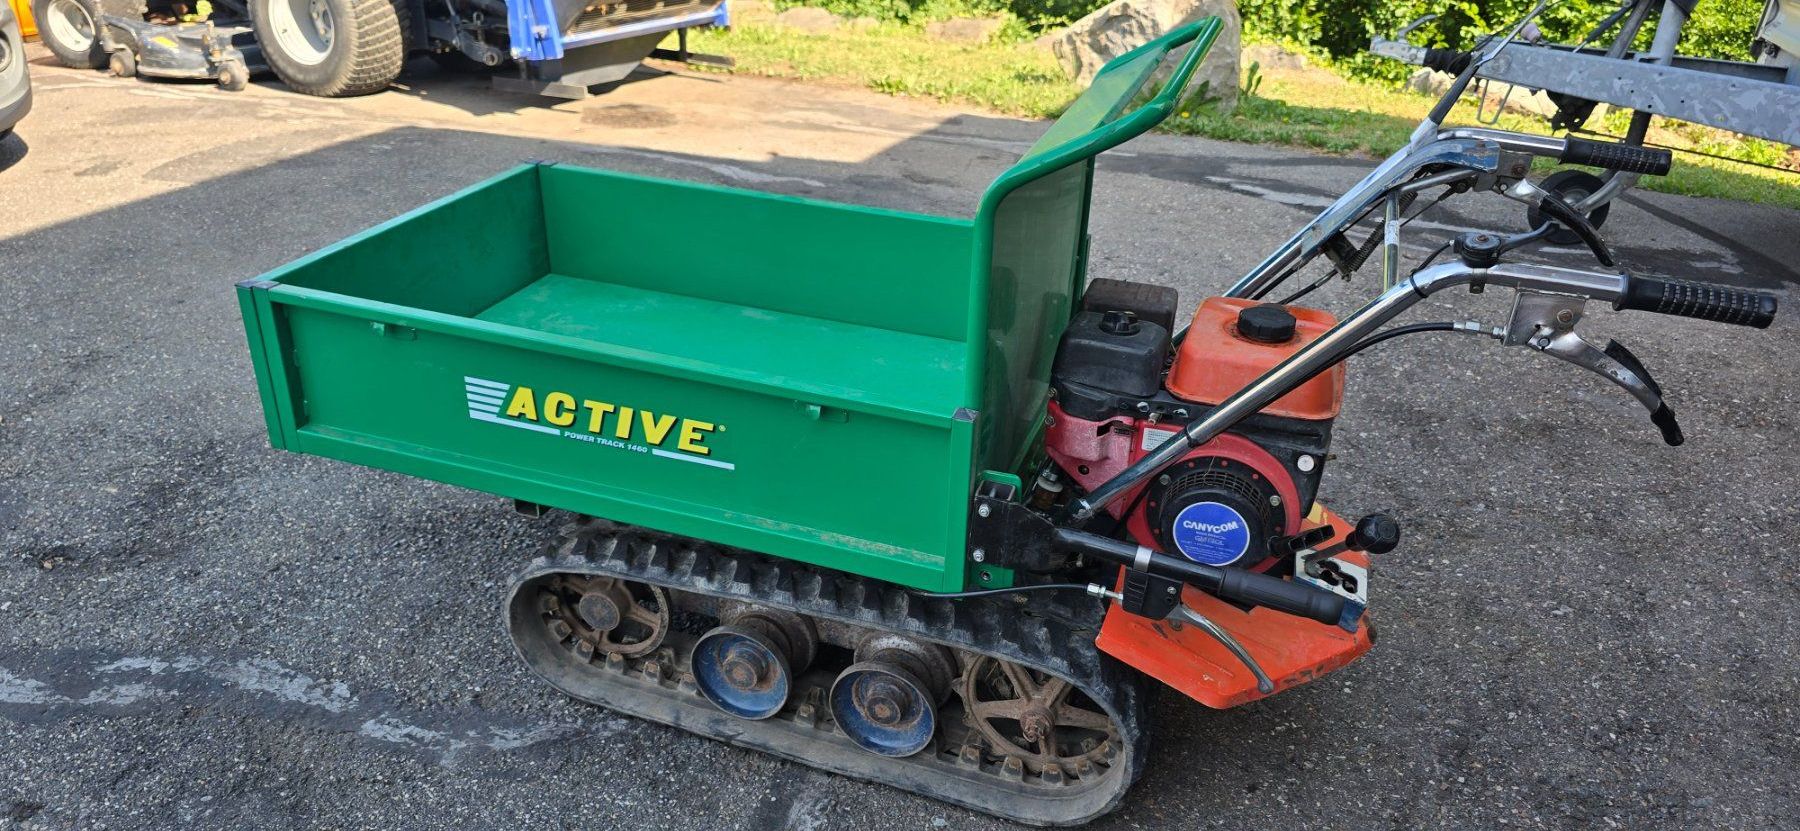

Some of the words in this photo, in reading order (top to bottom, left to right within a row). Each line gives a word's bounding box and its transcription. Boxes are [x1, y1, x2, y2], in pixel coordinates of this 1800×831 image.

[506, 386, 714, 456] ACTIVE
[564, 431, 595, 443] POWER
[596, 437, 625, 449] TRACK
[627, 444, 648, 453] 1460
[1183, 520, 1239, 534] CANYCOM
